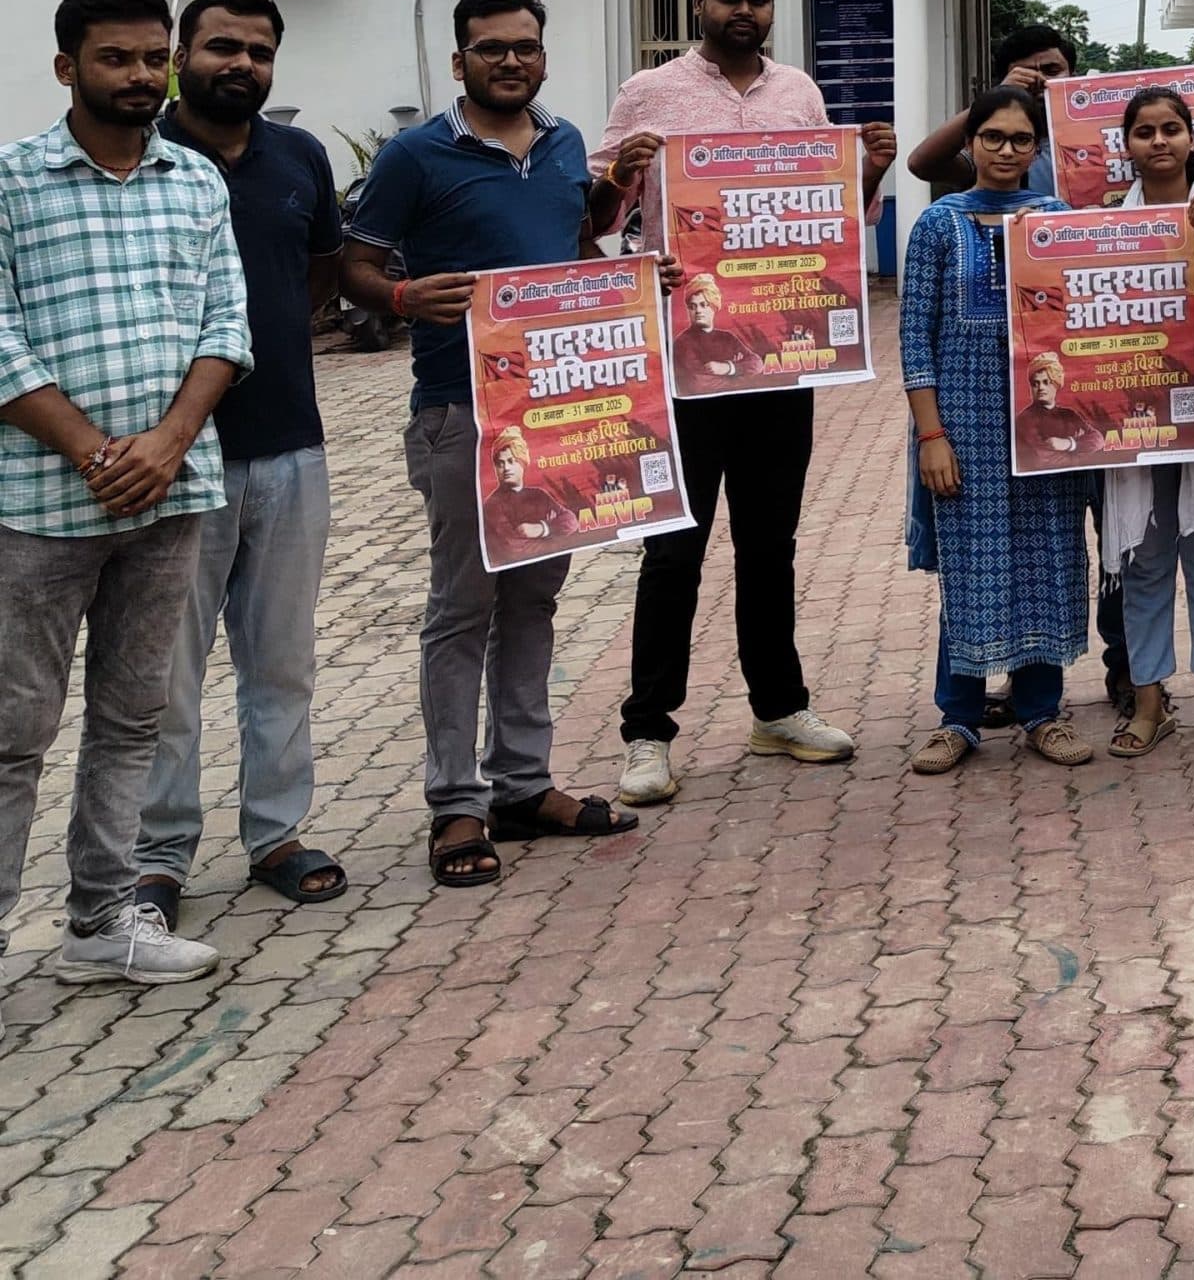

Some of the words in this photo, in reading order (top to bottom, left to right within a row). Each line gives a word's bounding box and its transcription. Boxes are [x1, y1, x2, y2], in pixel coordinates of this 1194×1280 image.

[1091, 88, 1119, 103] अखिल
[713, 147, 743, 160] अखिल
[746, 145, 776, 159] भारतीय
[778, 143, 807, 158] विद्यार्थी
[810, 144, 836, 157] परिषद्
[720, 183, 846, 218] सदस्यता
[723, 215, 845, 251] अभियान
[1055, 227, 1084, 241] अखिल
[1087, 225, 1117, 239] भारतीय
[1120, 222, 1148, 237] विद्यार्थी
[1152, 222, 1177, 236] परिषद्
[725, 263, 735, 273] 01
[766, 260, 775, 270] 31
[800, 257, 817, 267] 2025
[519, 284, 548, 302] अखिल
[551, 280, 580, 297] भारतीय
[583, 275, 610, 293] विद्यार्थी
[611, 272, 636, 290] परिषद्
[1062, 262, 1188, 298] सदस्यता
[1065, 294, 1187, 330] अभियान
[524, 316, 645, 361] सदस्यता
[1069, 342, 1078, 351] 01
[1109, 338, 1117, 348] 31
[1142, 335, 1159, 345] 2025
[761, 349, 836, 375] ABVP
[1133, 353, 1163, 371] विश्व
[529, 353, 647, 398] अभियान
[1116, 375, 1138, 390] छात्र
[532, 412, 541, 422] 01
[573, 406, 582, 416] 31
[607, 399, 622, 411] 2025
[599, 420, 628, 438] विश्व
[1103, 426, 1177, 451] ABVP
[584, 444, 606, 461] छात्र
[578, 497, 653, 532] ABVP
